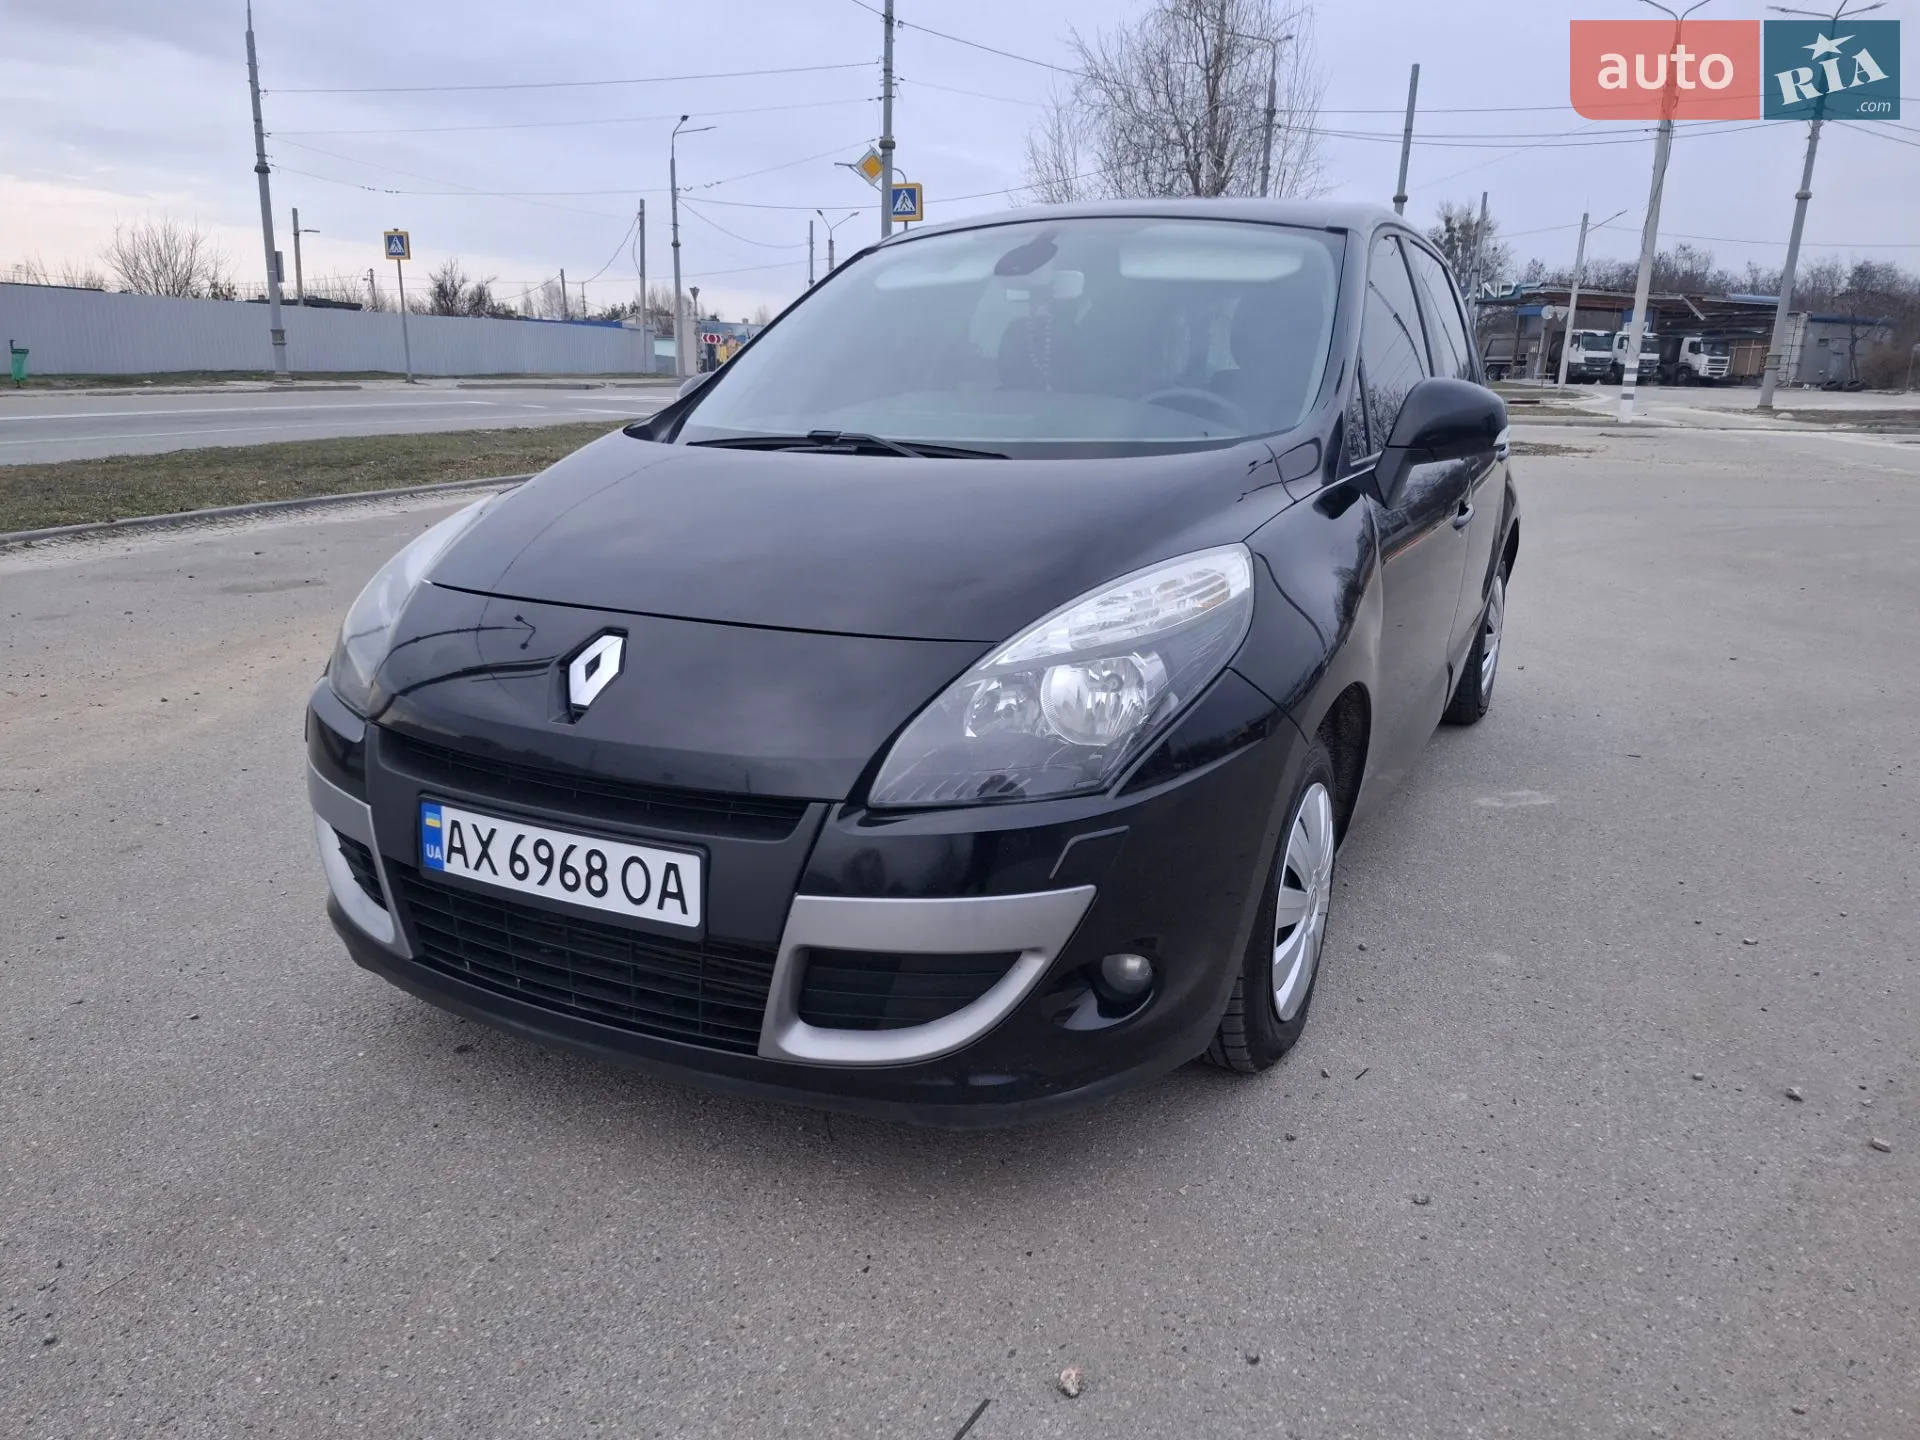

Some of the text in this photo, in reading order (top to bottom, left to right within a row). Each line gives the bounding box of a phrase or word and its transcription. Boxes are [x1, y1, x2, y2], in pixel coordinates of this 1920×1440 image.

[426, 843, 443, 862] UA
[446, 819, 689, 916] AX 6968 OA
